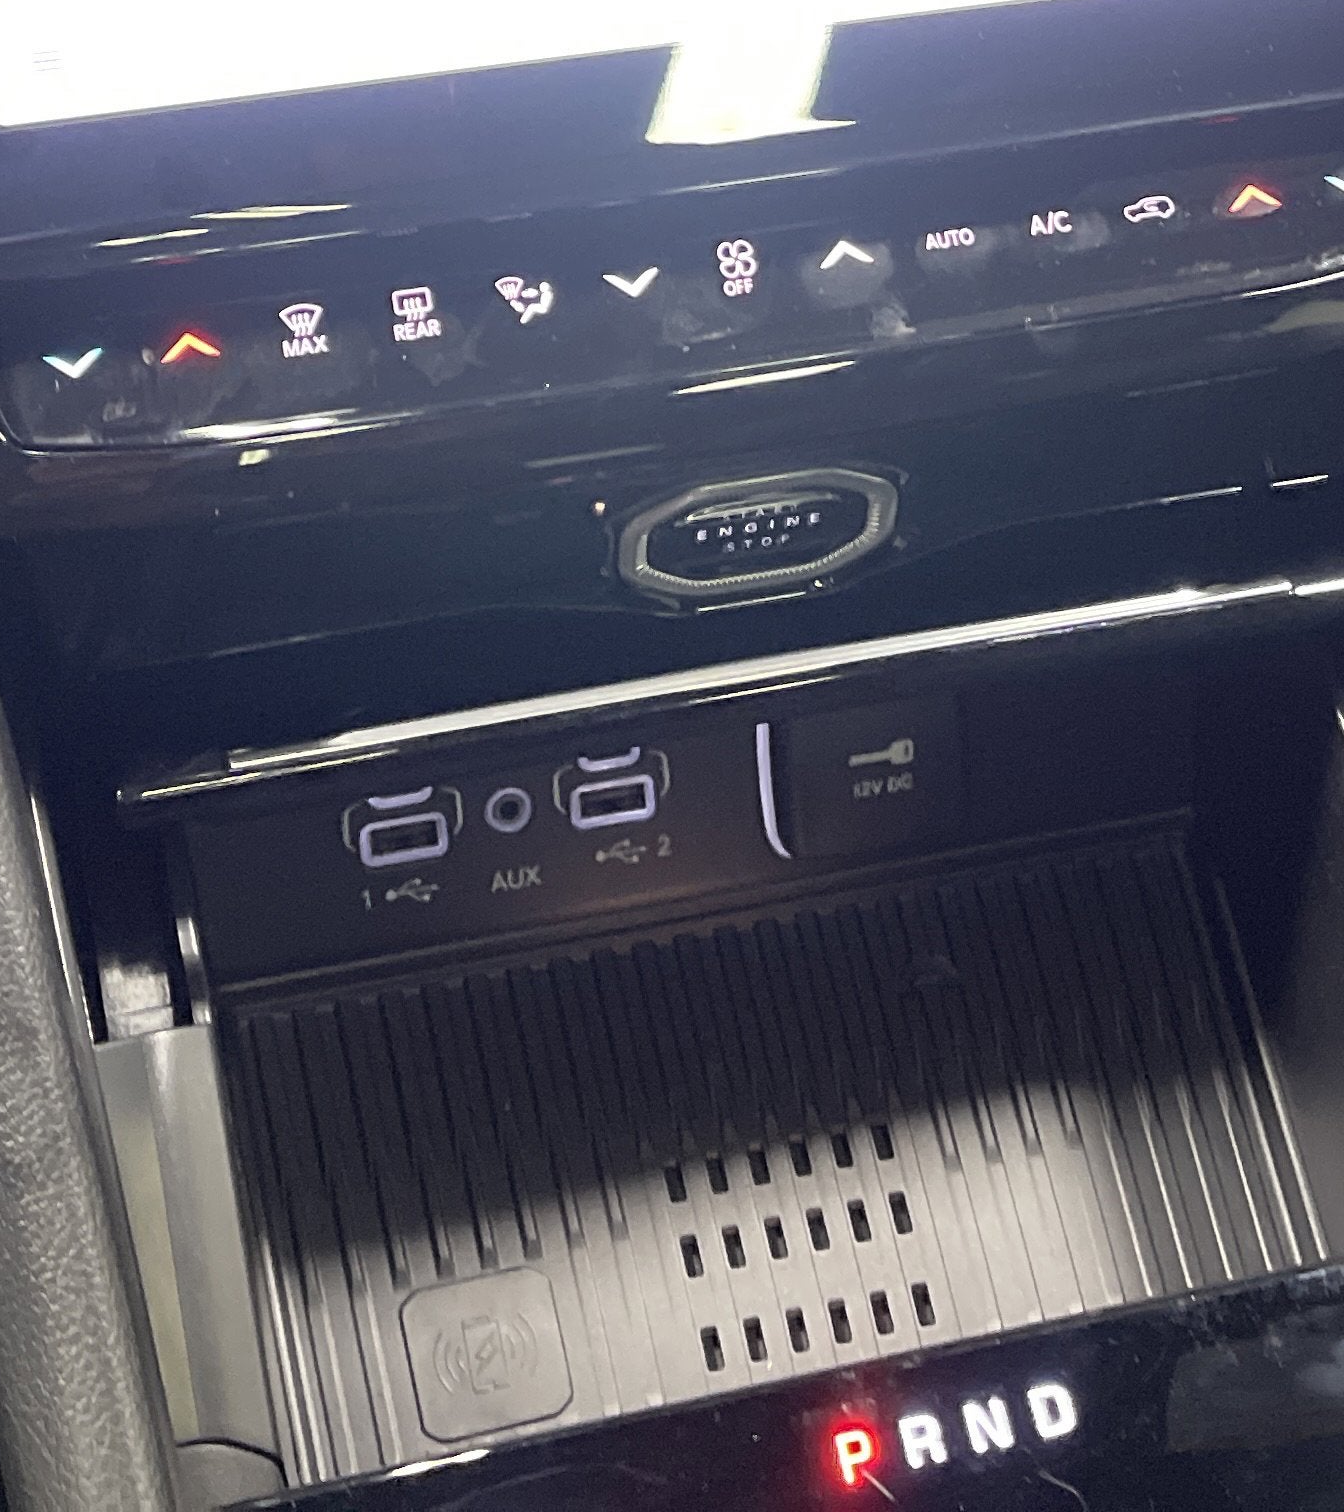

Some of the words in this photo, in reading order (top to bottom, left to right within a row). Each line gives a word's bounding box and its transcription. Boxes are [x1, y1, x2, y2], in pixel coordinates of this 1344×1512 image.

[1029, 210, 1073, 237] A/C
[924, 226, 975, 251] AUTO
[722, 277, 755, 297] OFF
[392, 318, 441, 341] REAR
[282, 334, 329, 358] MAX
[658, 834, 672, 857] 2
[491, 864, 543, 895] AUX
[832, 1429, 873, 1485] P
[898, 1414, 948, 1470] R
[961, 1395, 1015, 1454] N
[1027, 1384, 1078, 1441] D
